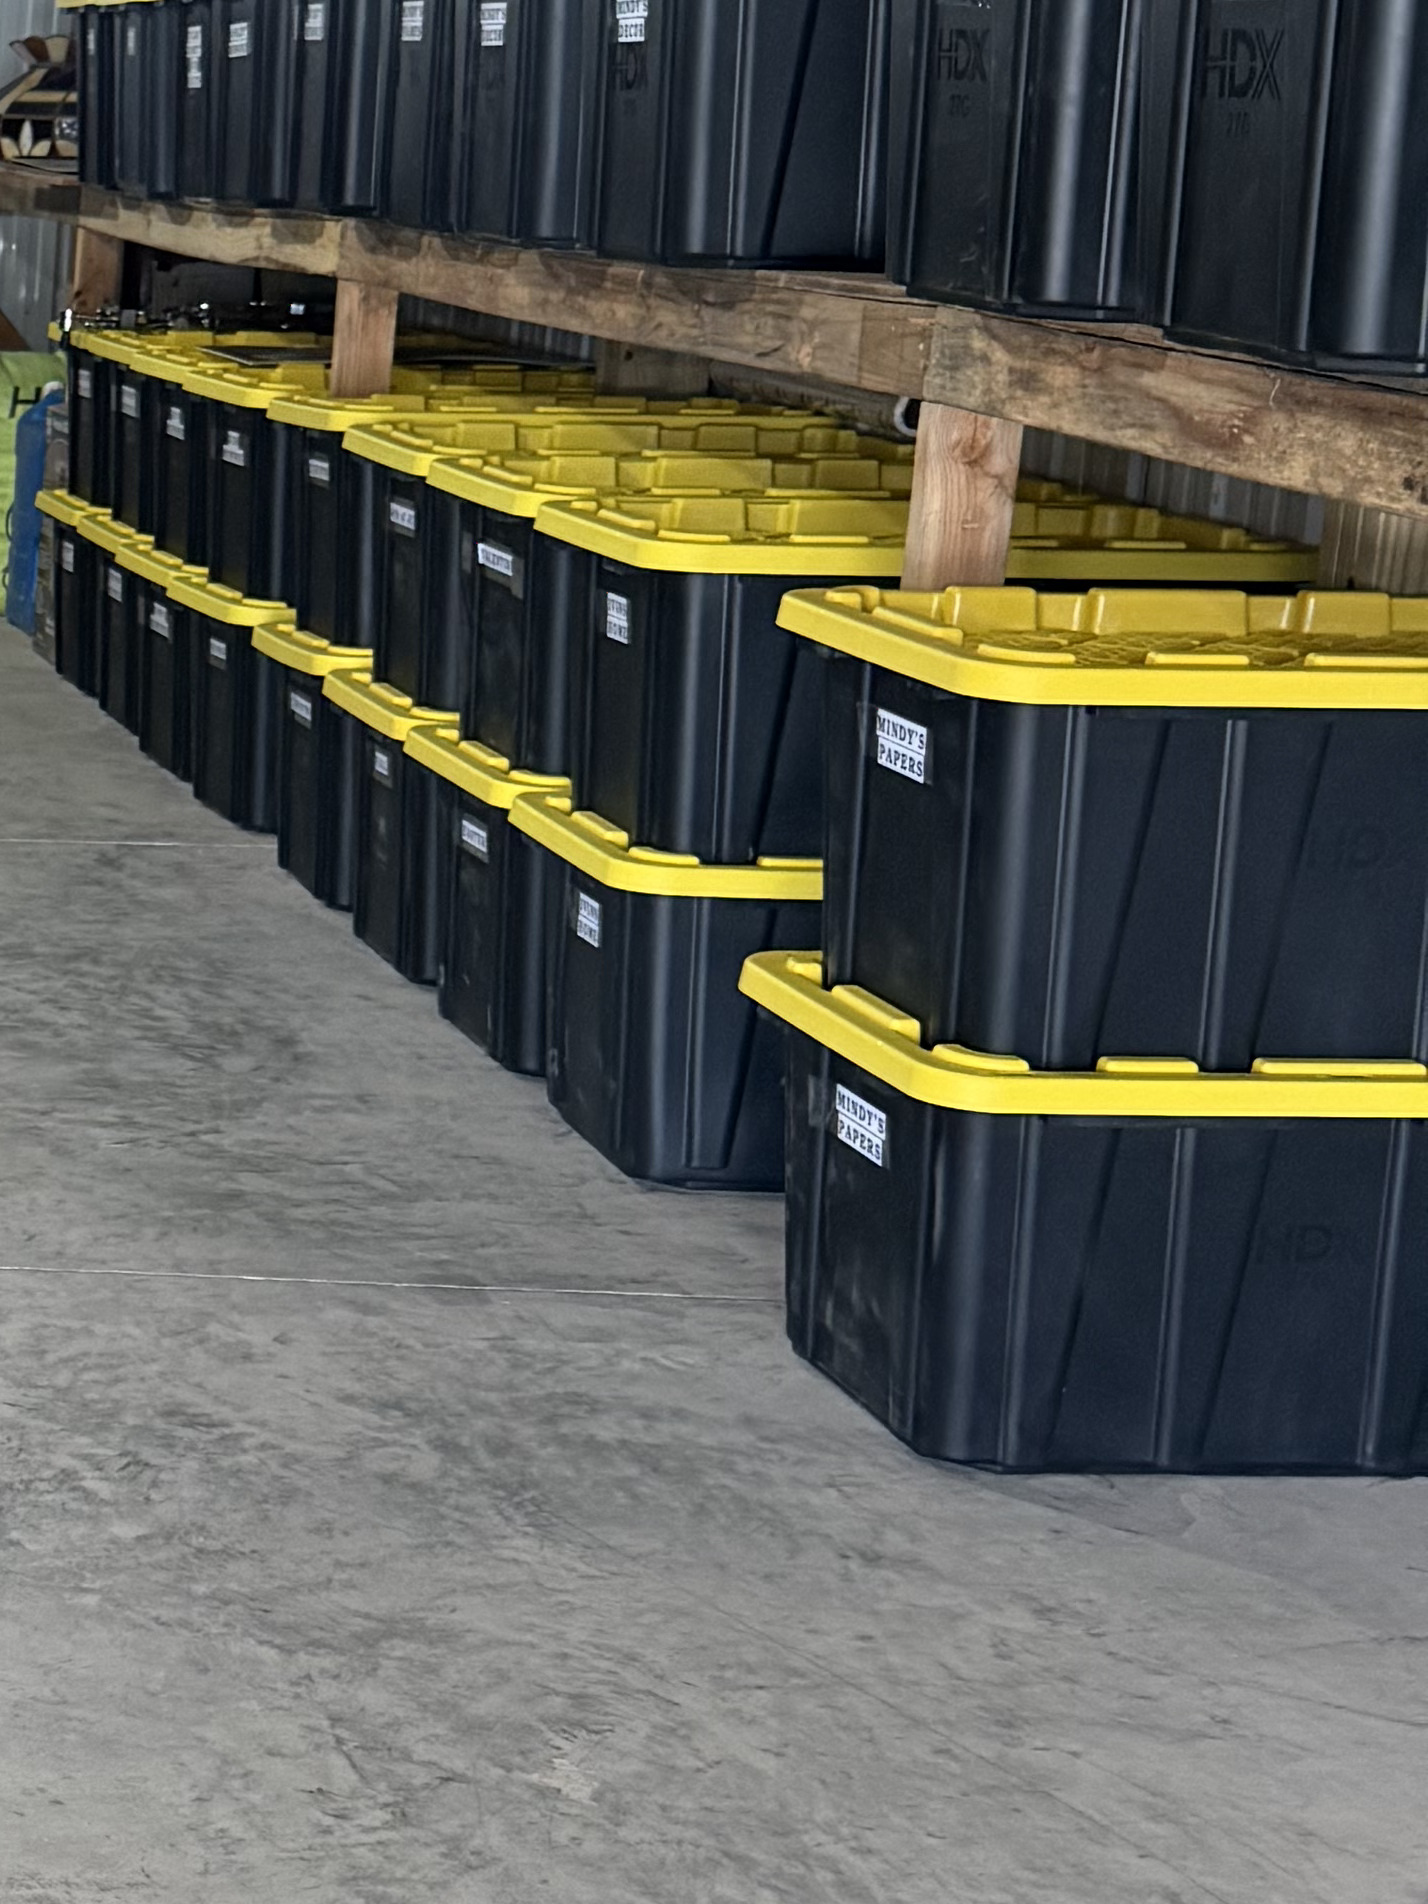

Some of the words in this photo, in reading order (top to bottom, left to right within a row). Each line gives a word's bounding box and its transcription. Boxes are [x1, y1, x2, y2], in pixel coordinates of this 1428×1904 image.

[1201, 26, 1285, 101] HDX
[877, 715, 925, 750] MINDY'S
[879, 743, 923, 777] PAPERS
[837, 1091, 884, 1135] MINDY'S
[839, 1119, 881, 1161] PAPERS
